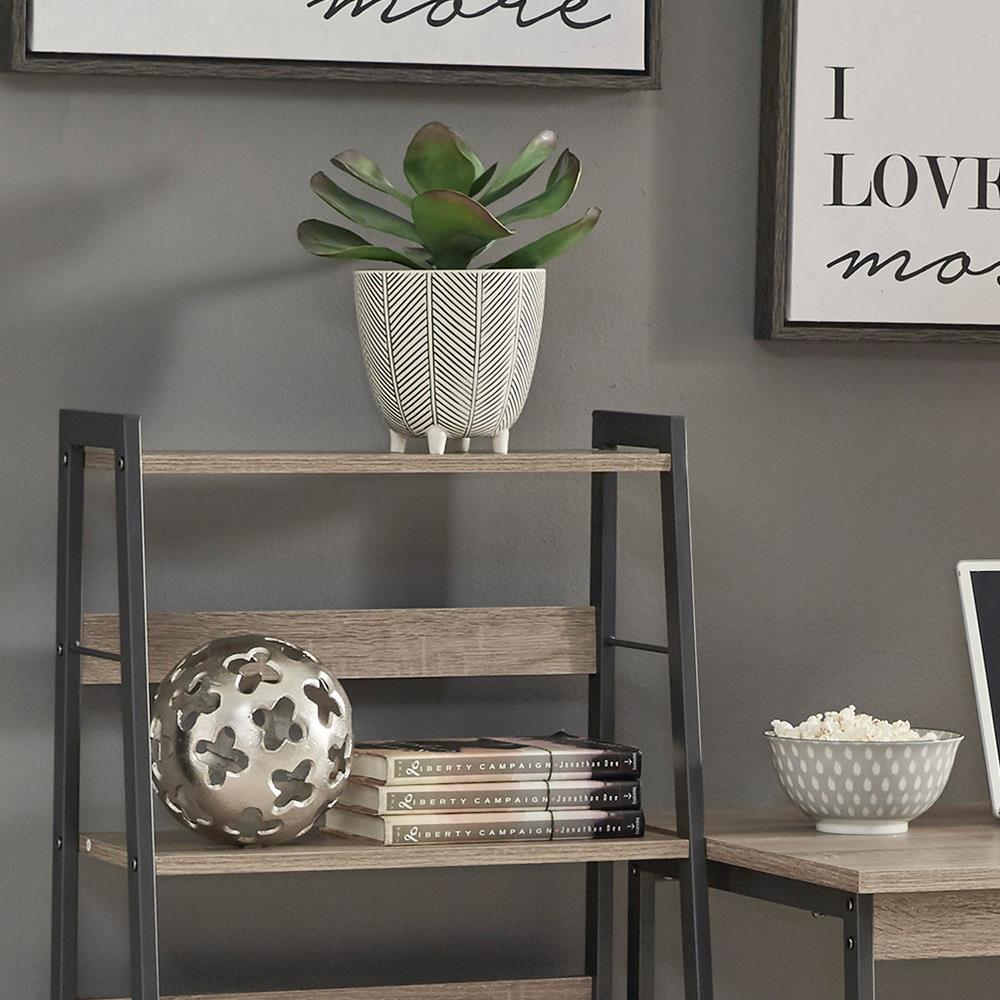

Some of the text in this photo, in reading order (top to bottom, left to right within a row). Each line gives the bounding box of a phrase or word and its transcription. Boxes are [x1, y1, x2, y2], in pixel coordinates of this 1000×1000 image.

[824, 66, 855, 120] I
[406, 759, 619, 776] LIBERTY CAMPAIGN Jonathan Dee
[399, 793, 618, 809] LIBERTY CAMPAIGN Jonathan Dee
[404, 824, 621, 842] LIBERTY CAMPAIGN Jonathan Dee
